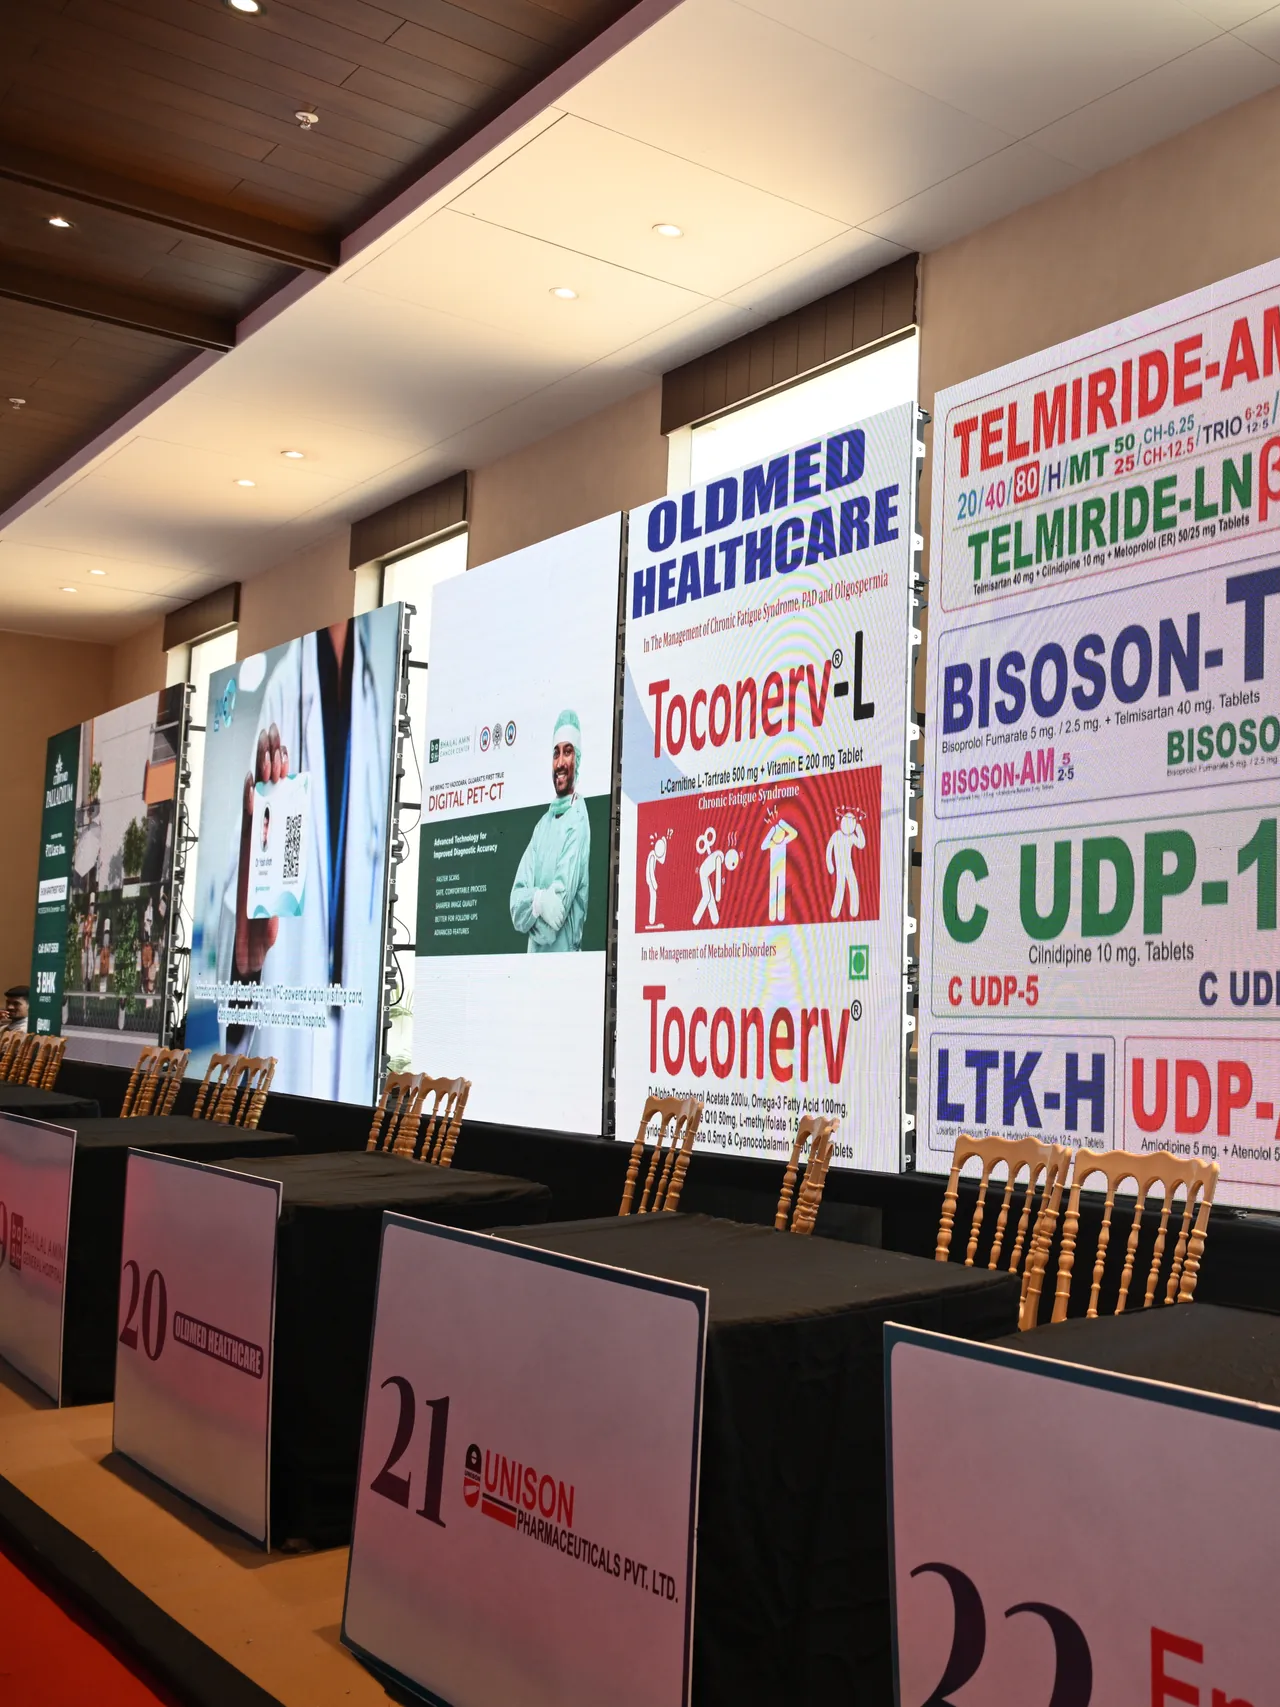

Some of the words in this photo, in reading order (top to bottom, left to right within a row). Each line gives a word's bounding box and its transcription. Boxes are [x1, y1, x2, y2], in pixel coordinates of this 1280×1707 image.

[647, 428, 866, 553] OLDMED
[632, 484, 899, 620] HEALTHCARE
[973, 577, 1012, 596] Telmisartan
[1013, 574, 1022, 586] 40
[1041, 559, 1081, 580] Cilnidipine
[1083, 555, 1092, 567] 10
[1114, 540, 1157, 558] Metoprolol
[1158, 534, 1176, 550] (ER)
[1178, 527, 1200, 543] 50/25
[1218, 513, 1250, 532] Tablets
[643, 638, 650, 653] In
[651, 635, 662, 651] The
[663, 624, 702, 648] Management
[702, 618, 710, 634] of
[710, 615, 736, 634] Chronic
[736, 609, 762, 627] Fatigue
[763, 598, 801, 623] Syndrome,
[802, 589, 817, 608] PAD
[819, 584, 833, 604] and
[834, 572, 888, 600] Oligospermia
[942, 738, 982, 754] Bisoprolol
[986, 730, 1028, 747] Fumarate
[1030, 728, 1037, 739] 5
[1065, 719, 1081, 733] 2.5
[1115, 709, 1174, 725] Telmisartan
[1177, 702, 1191, 715] 40
[1219, 690, 1260, 709] Tablets
[660, 775, 696, 794] L-Carnitine
[697, 769, 731, 788] L-Tartrate
[732, 767, 745, 782] 500
[767, 758, 796, 777] Vitamin
[798, 756, 803, 772] E
[805, 753, 820, 770] 200
[838, 747, 864, 765] Tablet
[941, 747, 1055, 796] BISOSON-AM
[429, 790, 464, 812] DIGITAL
[467, 782, 504, 805] PET-CT
[698, 794, 727, 811] Chronic
[728, 790, 757, 809] Fatigue
[758, 784, 800, 804] Syndrome
[433, 849, 453, 860] Improved
[454, 845, 476, 857] Diagnostic
[477, 844, 498, 853] Accuracy
[455, 833, 479, 843] Technology
[943, 848, 990, 943] C
[641, 947, 648, 961] In
[648, 946, 658, 960] the
[660, 946, 699, 964] Management
[699, 944, 707, 959] of
[708, 943, 741, 959] Metabolic
[742, 941, 777, 957] Disorders
[1028, 944, 1092, 968] Cilnidipine
[1097, 944, 1113, 962] 10
[1145, 941, 1194, 962] Tablets
[37, 972, 42, 993] 3
[42, 972, 57, 993] BHK
[948, 976, 963, 1005] C
[970, 974, 1039, 1006] UDP-5
[1199, 972, 1218, 1005] C
[706, 1094, 729, 1106] Acetate
[752, 1094, 781, 1111] Omega-3
[783, 1096, 800, 1111] Fatty
[803, 1098, 819, 1112] Acid
[821, 1099, 848, 1117] 100mg,
[936, 1048, 1106, 1133] LTK-H
[705, 1112, 717, 1123] Q10
[740, 1114, 787, 1131] L-methylfolate
[707, 1130, 727, 1143] 0.5mg
[734, 1134, 789, 1151] Cyanocobalamin
[1141, 1138, 1190, 1154] Amlodipine
[1193, 1142, 1199, 1154] 5
[1231, 1145, 1271, 1160] Atenolol
[119, 1260, 168, 1361] 20
[175, 1315, 206, 1345] OLDMED
[207, 1322, 261, 1375] HEALTHCARE
[370, 1375, 450, 1529] 21
[485, 1449, 574, 1529] UNISON
[517, 1508, 621, 1579] PHARMACEUTICALS
[623, 1559, 649, 1591] PVT.
[651, 1571, 679, 1604] LTD.
